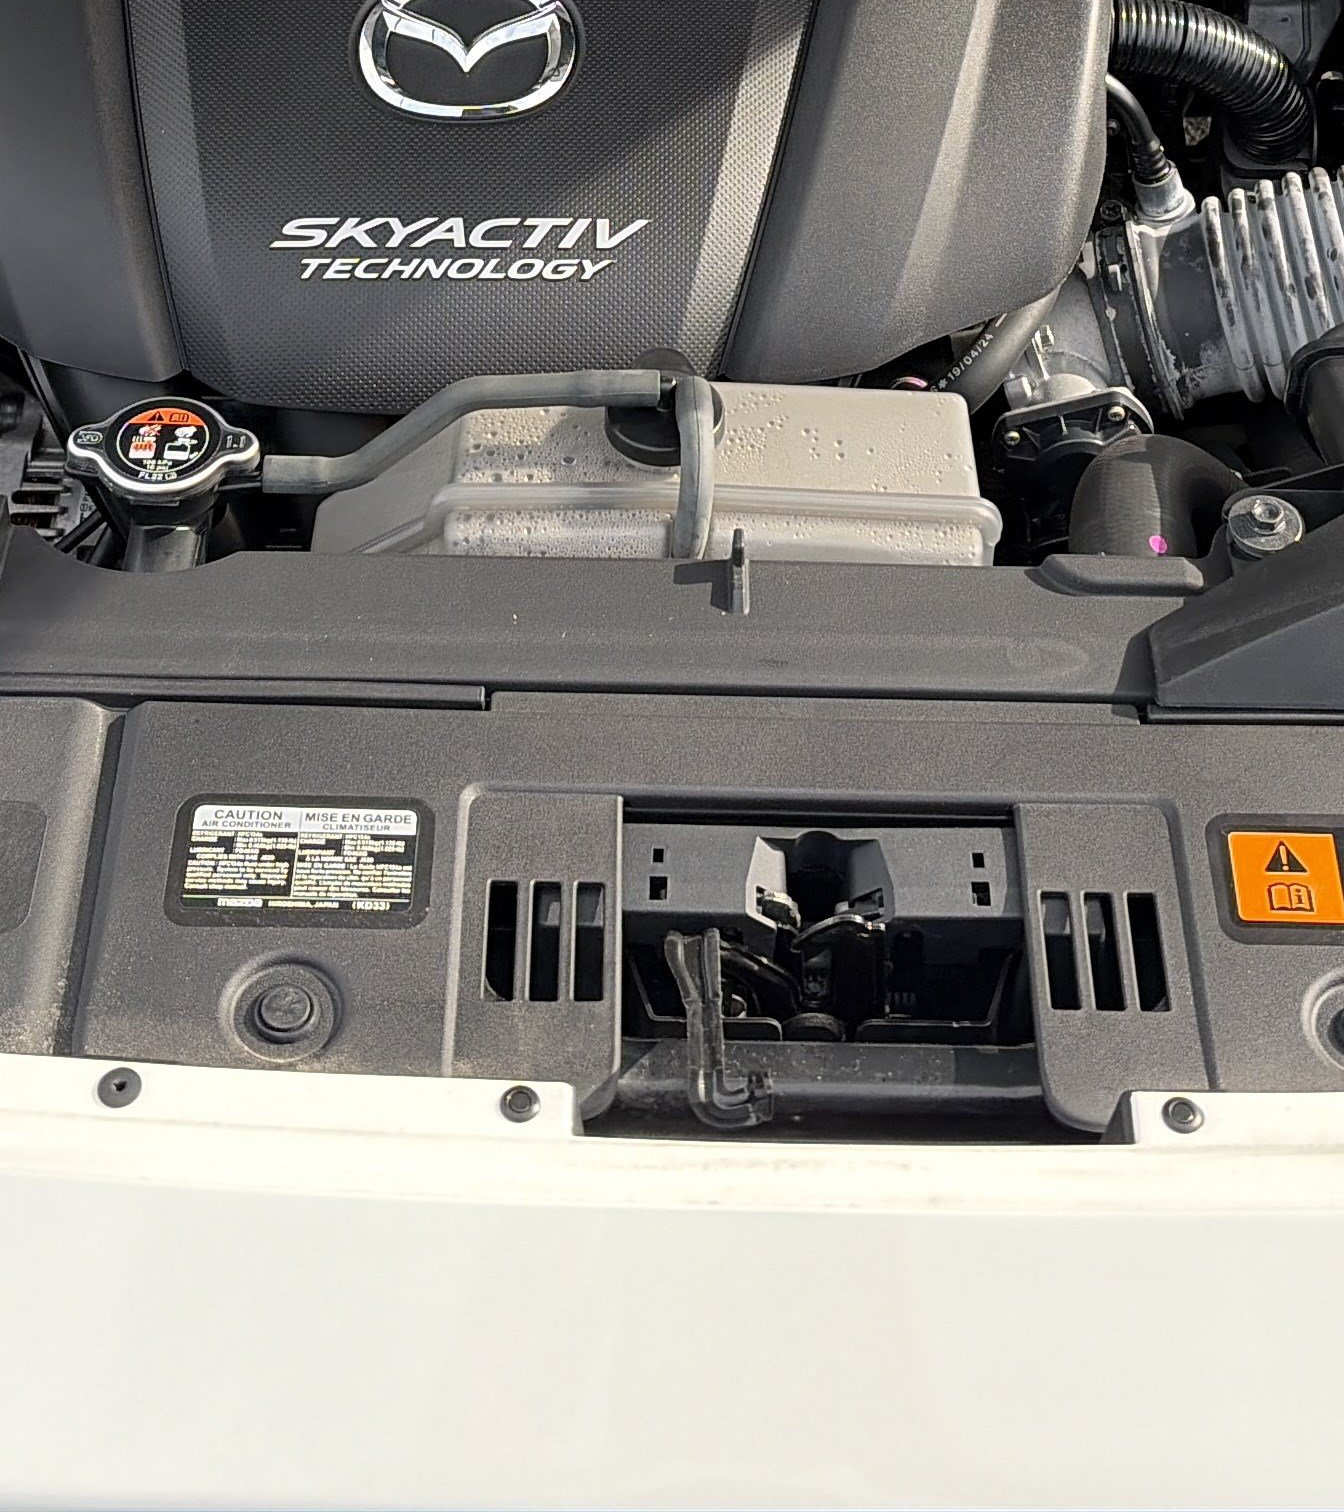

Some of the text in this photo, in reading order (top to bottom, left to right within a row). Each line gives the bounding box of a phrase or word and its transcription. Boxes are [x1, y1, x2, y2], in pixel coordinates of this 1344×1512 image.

[269, 217, 652, 250] SKYACTIV
[300, 257, 615, 281] TECHNOLOGY
[214, 809, 283, 820] CAUTION
[305, 812, 412, 824] MISE EN GARDE
[223, 820, 292, 829] CONDITIONER
[322, 823, 391, 832] CLIMATISEUR
